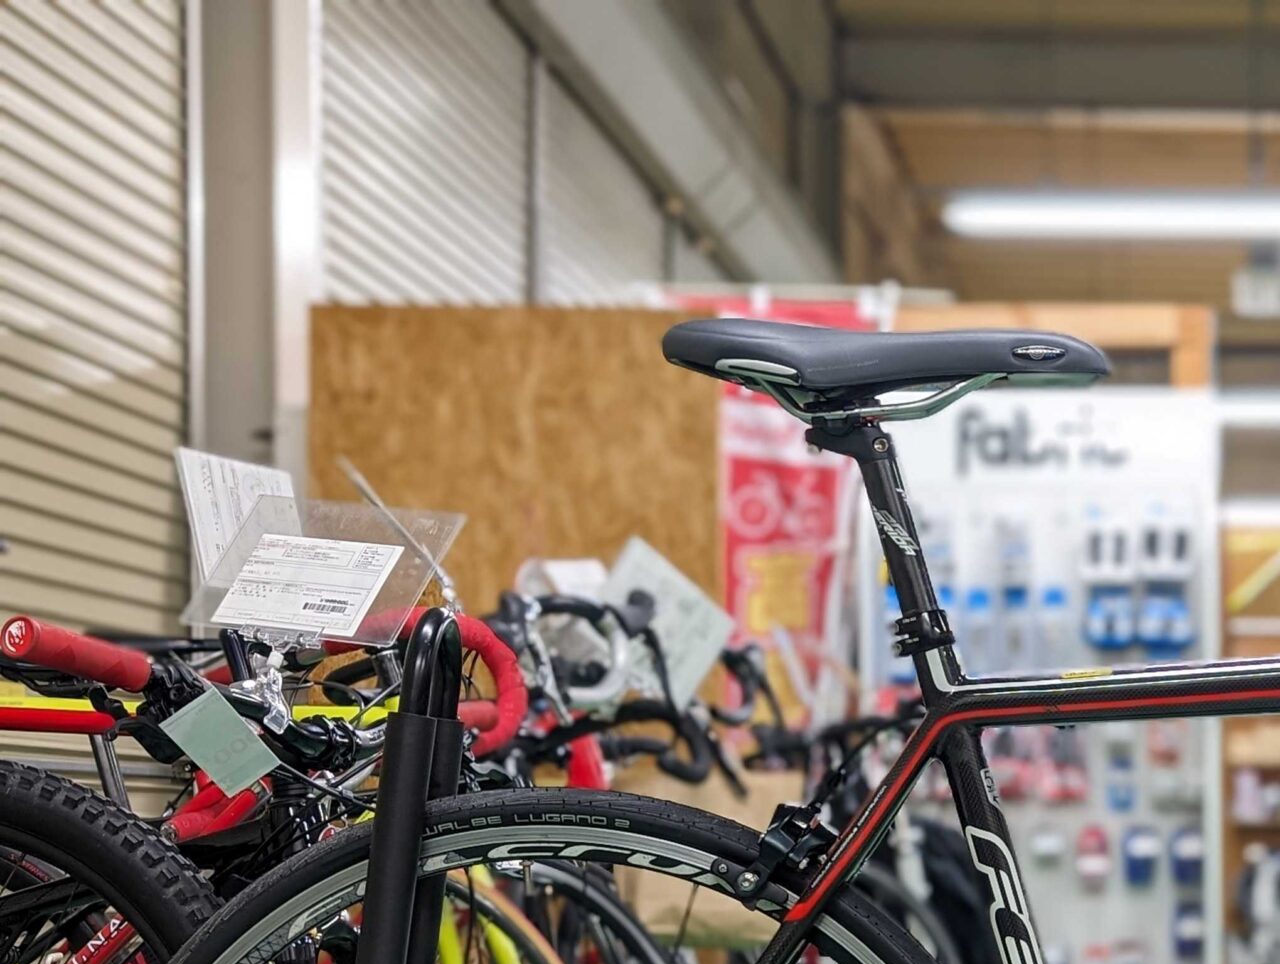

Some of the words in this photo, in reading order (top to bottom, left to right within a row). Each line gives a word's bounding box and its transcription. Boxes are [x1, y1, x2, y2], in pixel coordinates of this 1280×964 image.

[424, 815, 502, 837] WALBE
[513, 812, 608, 827] LUGANO
[615, 819, 631, 829] 2
